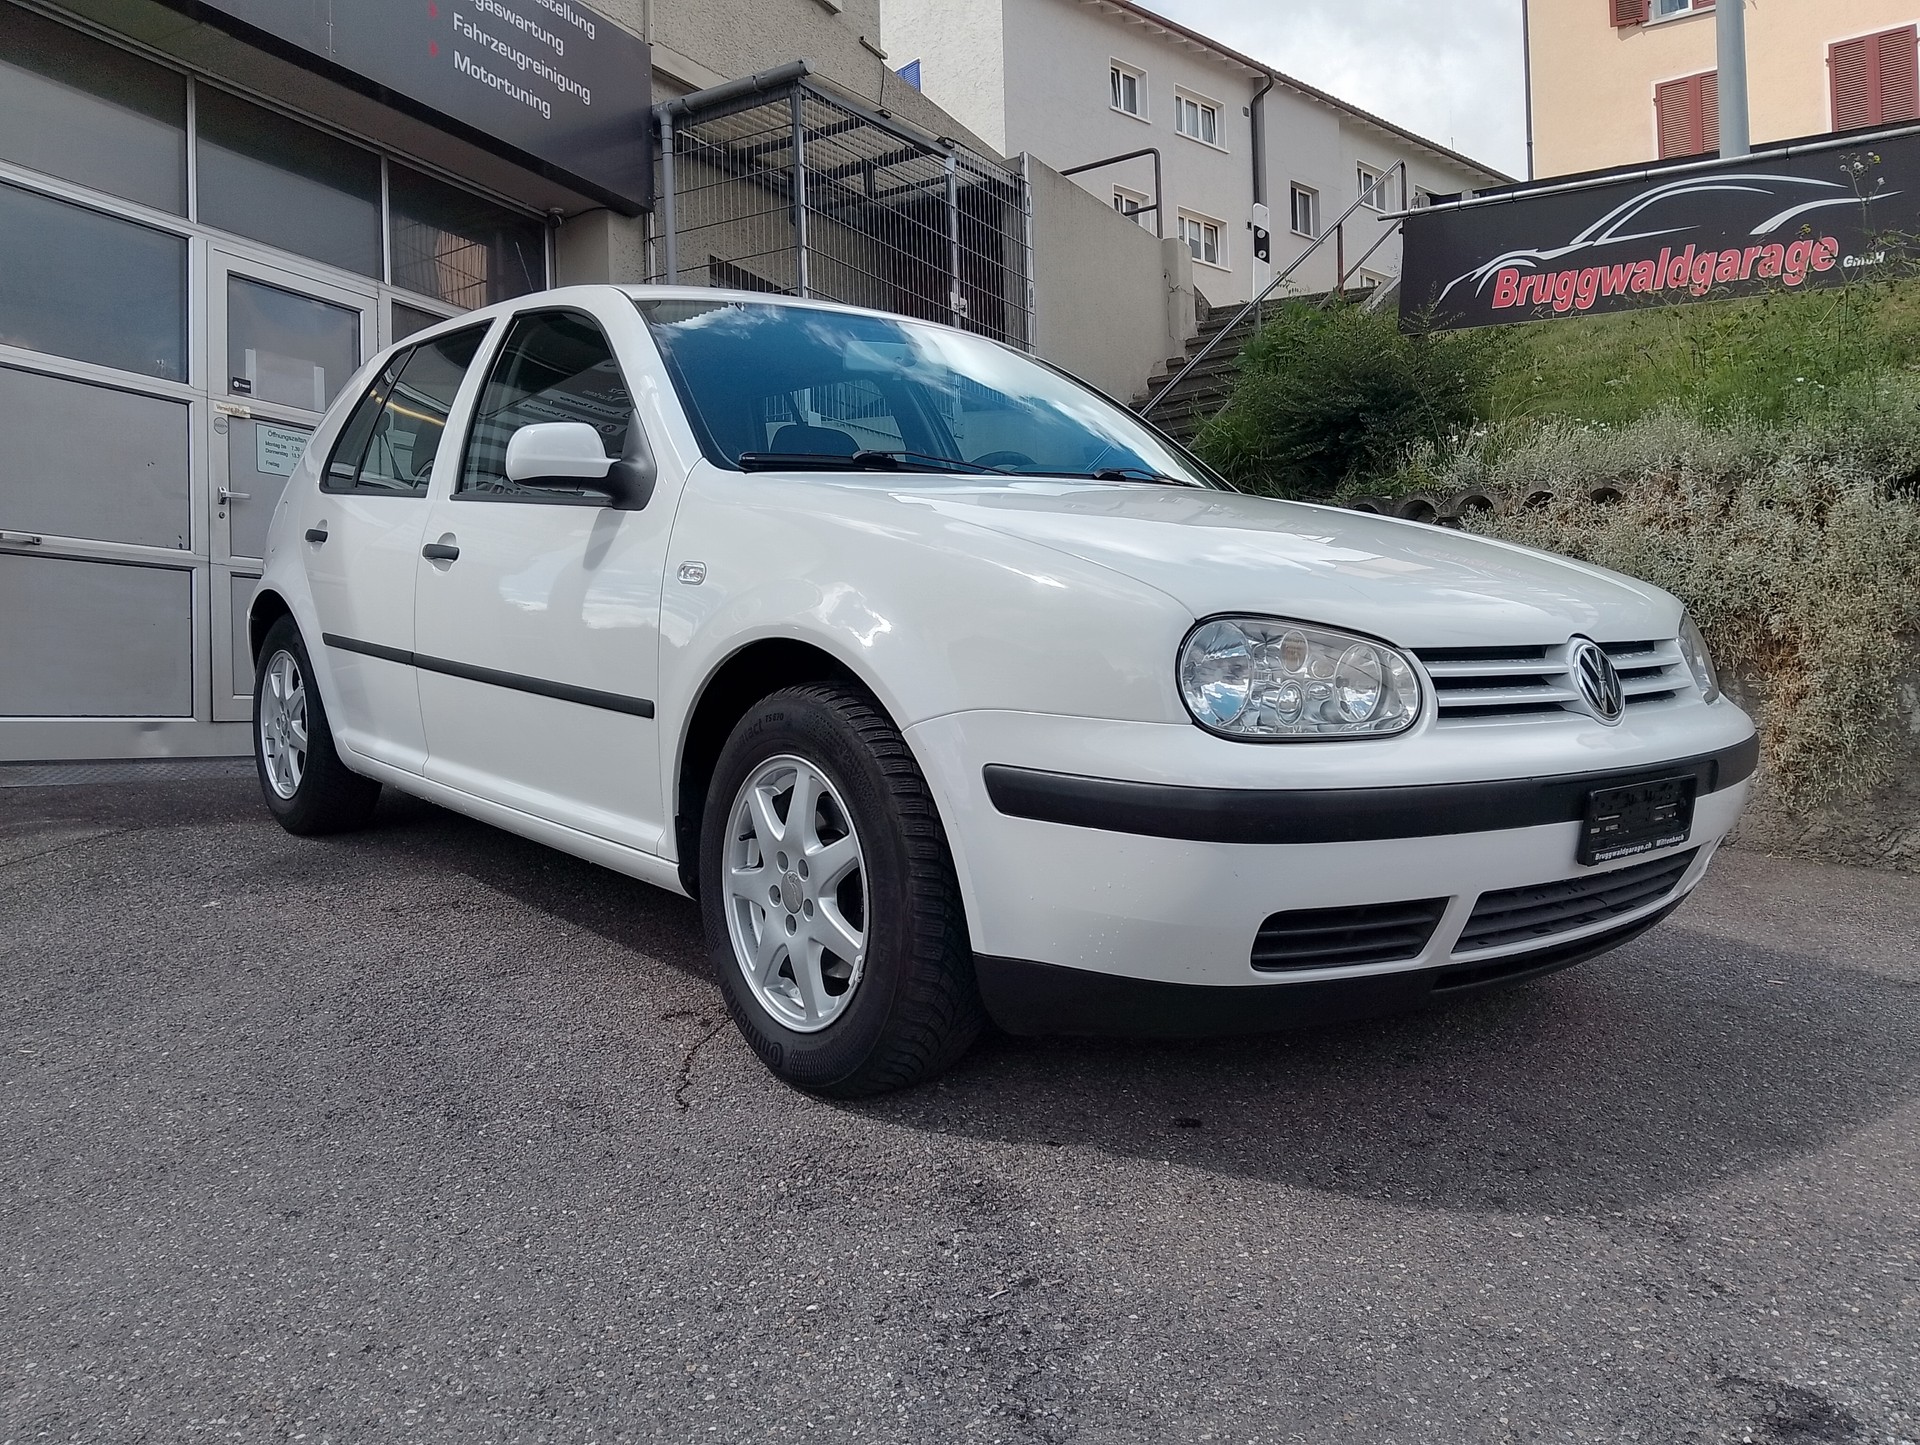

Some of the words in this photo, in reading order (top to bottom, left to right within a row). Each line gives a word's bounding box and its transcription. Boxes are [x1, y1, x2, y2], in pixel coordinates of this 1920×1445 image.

[470, 0, 564, 56] gaswartung
[536, 0, 595, 40] stellung
[453, 12, 591, 106] Fahrzeugreinigung
[453, 50, 551, 120] Motortuning
[1491, 235, 1839, 312] Bruggwaldgarage
[265, 440, 280, 449] Montag
[265, 448, 288, 458] Donnerstag
[266, 460, 280, 468] Freitag
[1594, 841, 1653, 861] Bruggwaldgarage.ch
